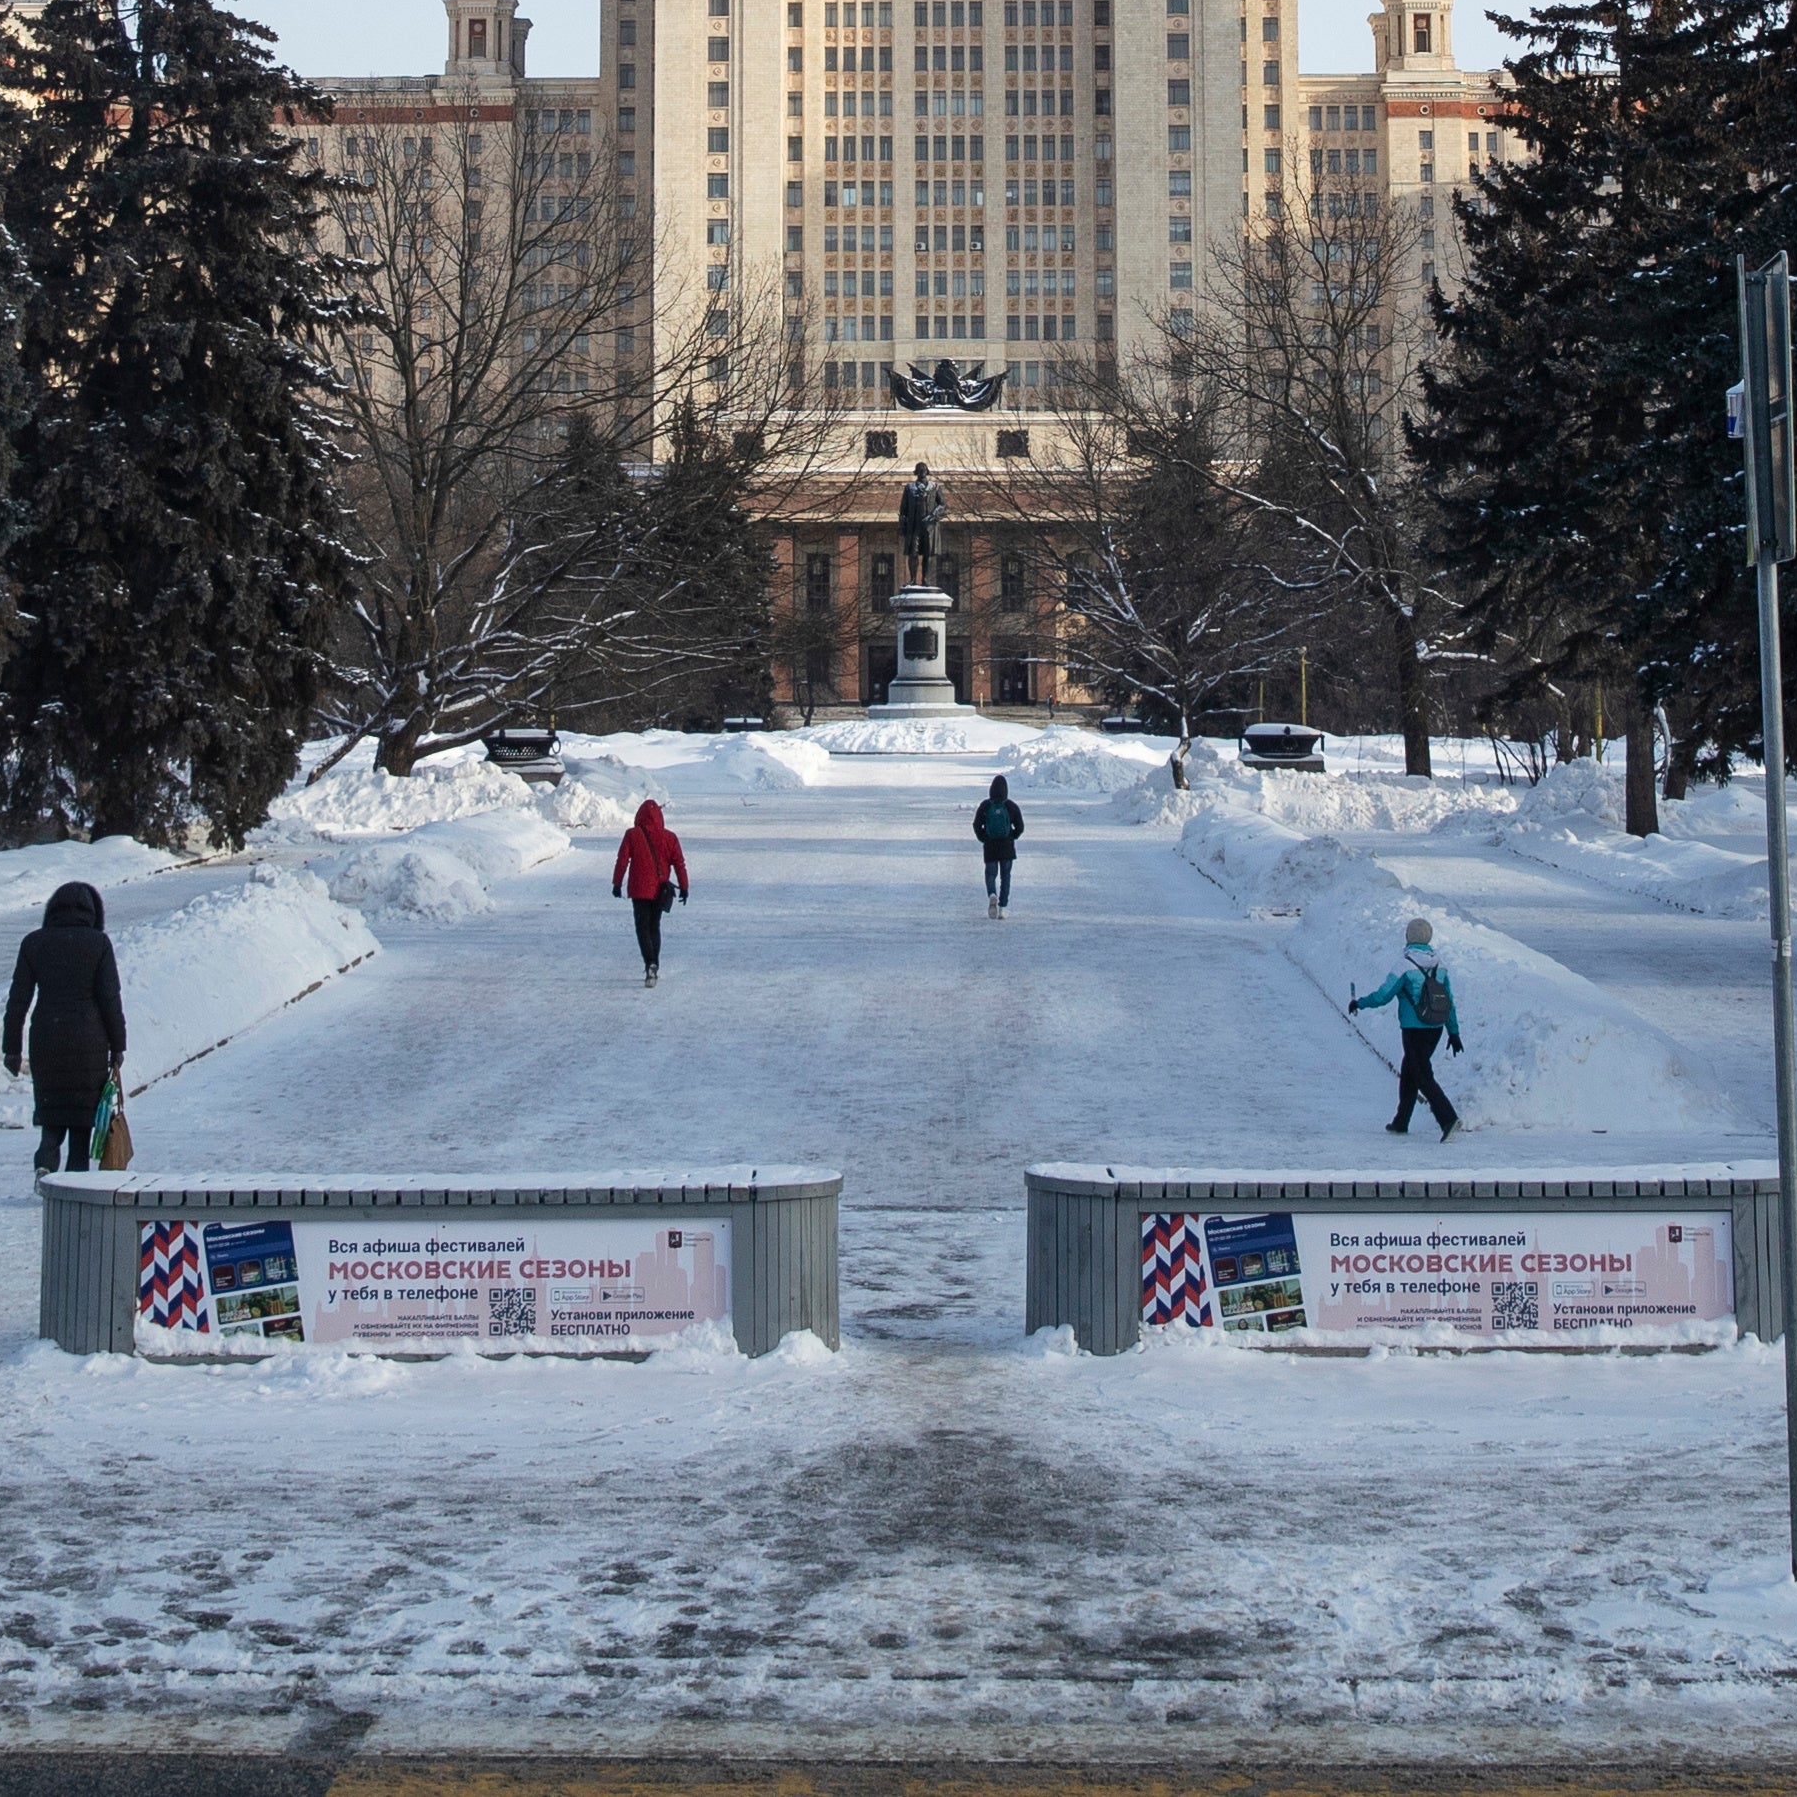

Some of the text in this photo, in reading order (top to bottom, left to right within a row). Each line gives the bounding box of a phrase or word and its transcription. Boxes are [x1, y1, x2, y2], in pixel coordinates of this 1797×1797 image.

[329, 1238, 525, 1256] Вся афиша фестивалей
[1330, 1231, 1526, 1250] Вся афиша фестивалей
[329, 1259, 631, 1280] МОСКОВСКИЕ СЕЗОНЫ
[1330, 1253, 1632, 1273] МОСКОВСКИЕ СЕЗОНЫ
[328, 1285, 479, 1304] у тебя в телефоне
[1330, 1278, 1481, 1297] у тебя в телефоне
[1563, 1288, 1577, 1296] App
[551, 1309, 695, 1322] Установи приложение
[1553, 1303, 1697, 1317] Установи приложение
[551, 1324, 631, 1336] БЕСПЛАТНО
